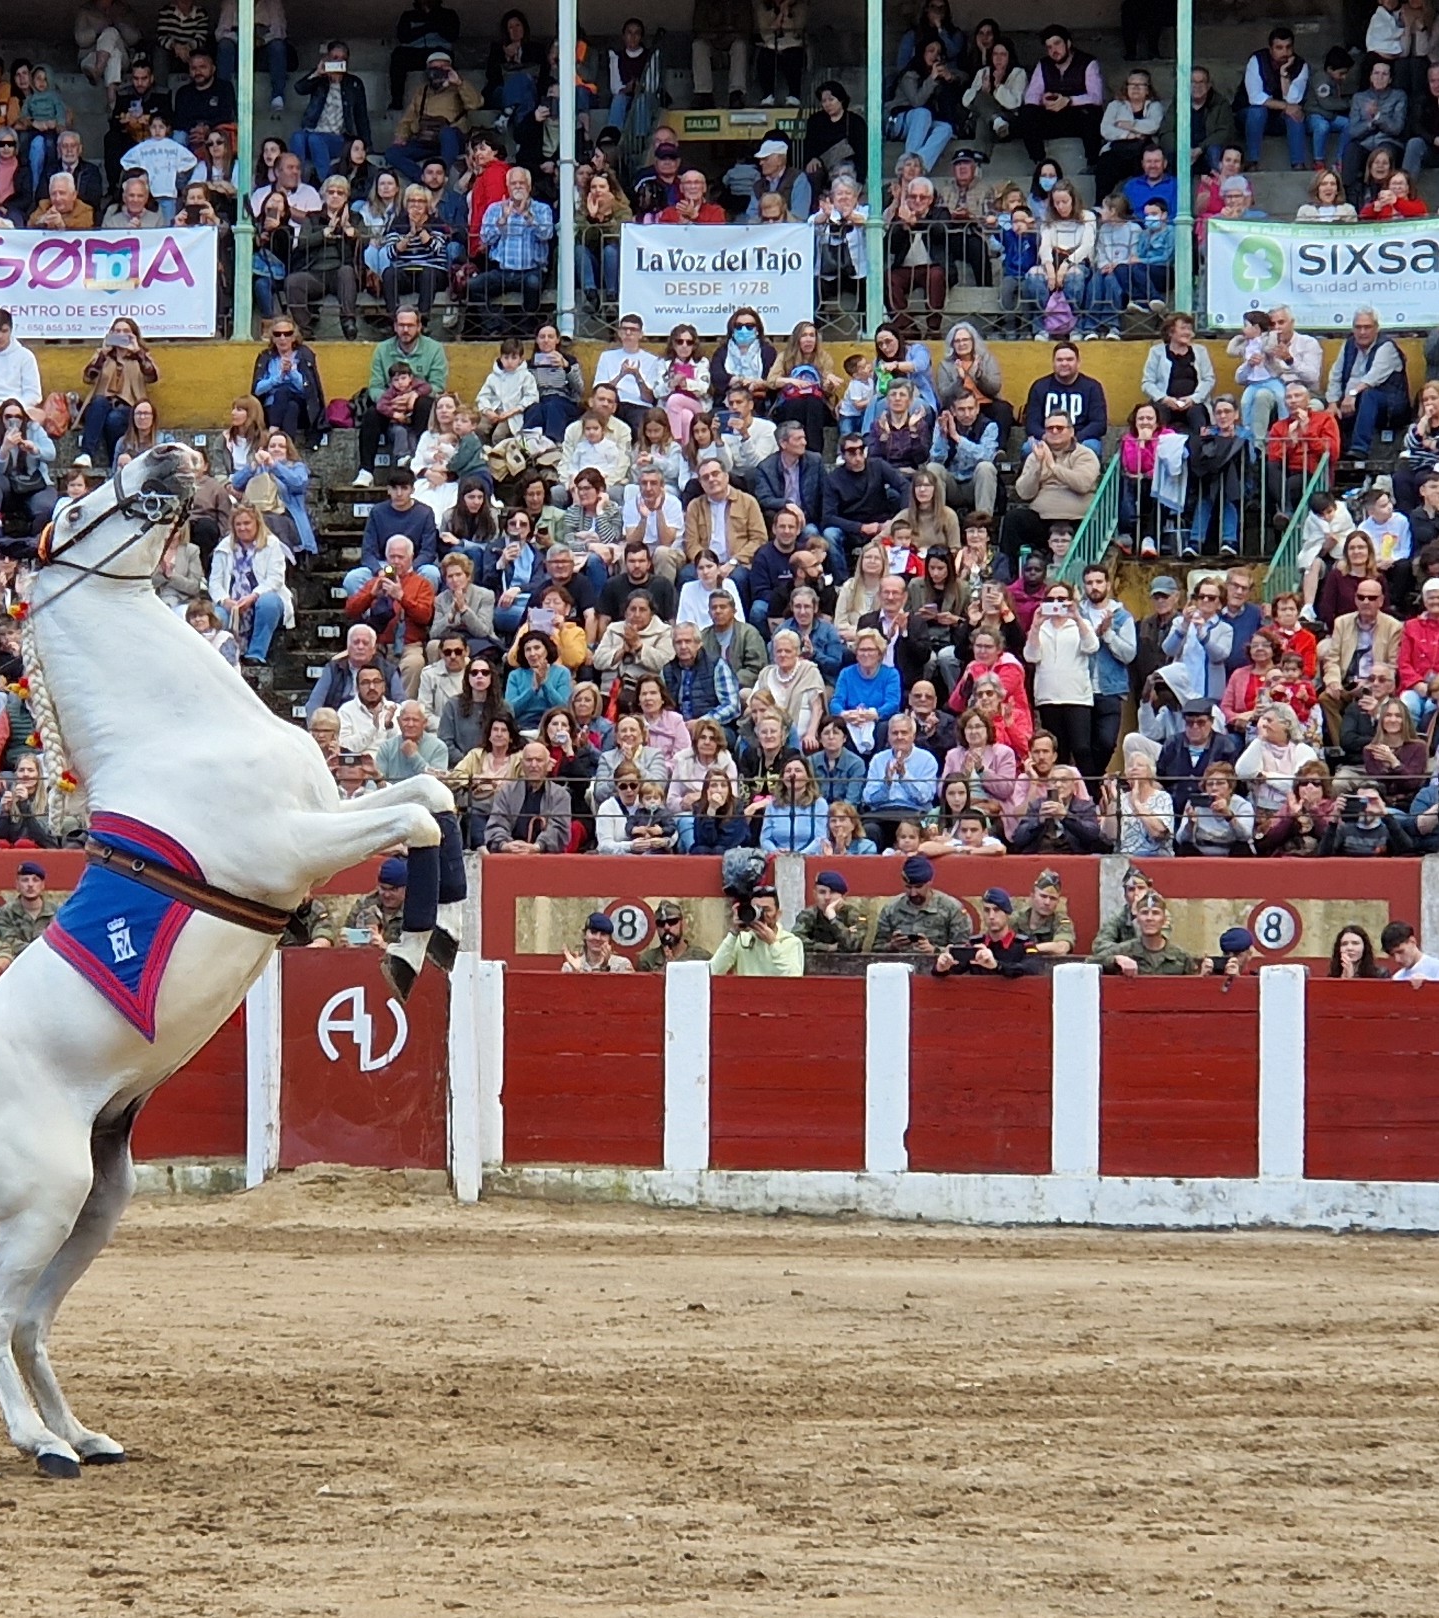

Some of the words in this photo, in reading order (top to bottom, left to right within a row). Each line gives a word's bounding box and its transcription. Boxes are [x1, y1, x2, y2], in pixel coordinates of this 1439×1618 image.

[686, 119, 719, 129] SALIDA
[636, 247, 663, 272] La
[667, 248, 706, 272] Voz
[712, 248, 747, 272] del
[752, 246, 802, 275] Tajo
[664, 281, 722, 296] DESDE
[730, 281, 770, 295] 1978
[1297, 278, 1358, 293] sanidad
[65, 304, 85, 317] DE
[90, 304, 166, 317] ESTUDIOS
[617, 907, 637, 940] 8
[1263, 912, 1283, 943] 8
